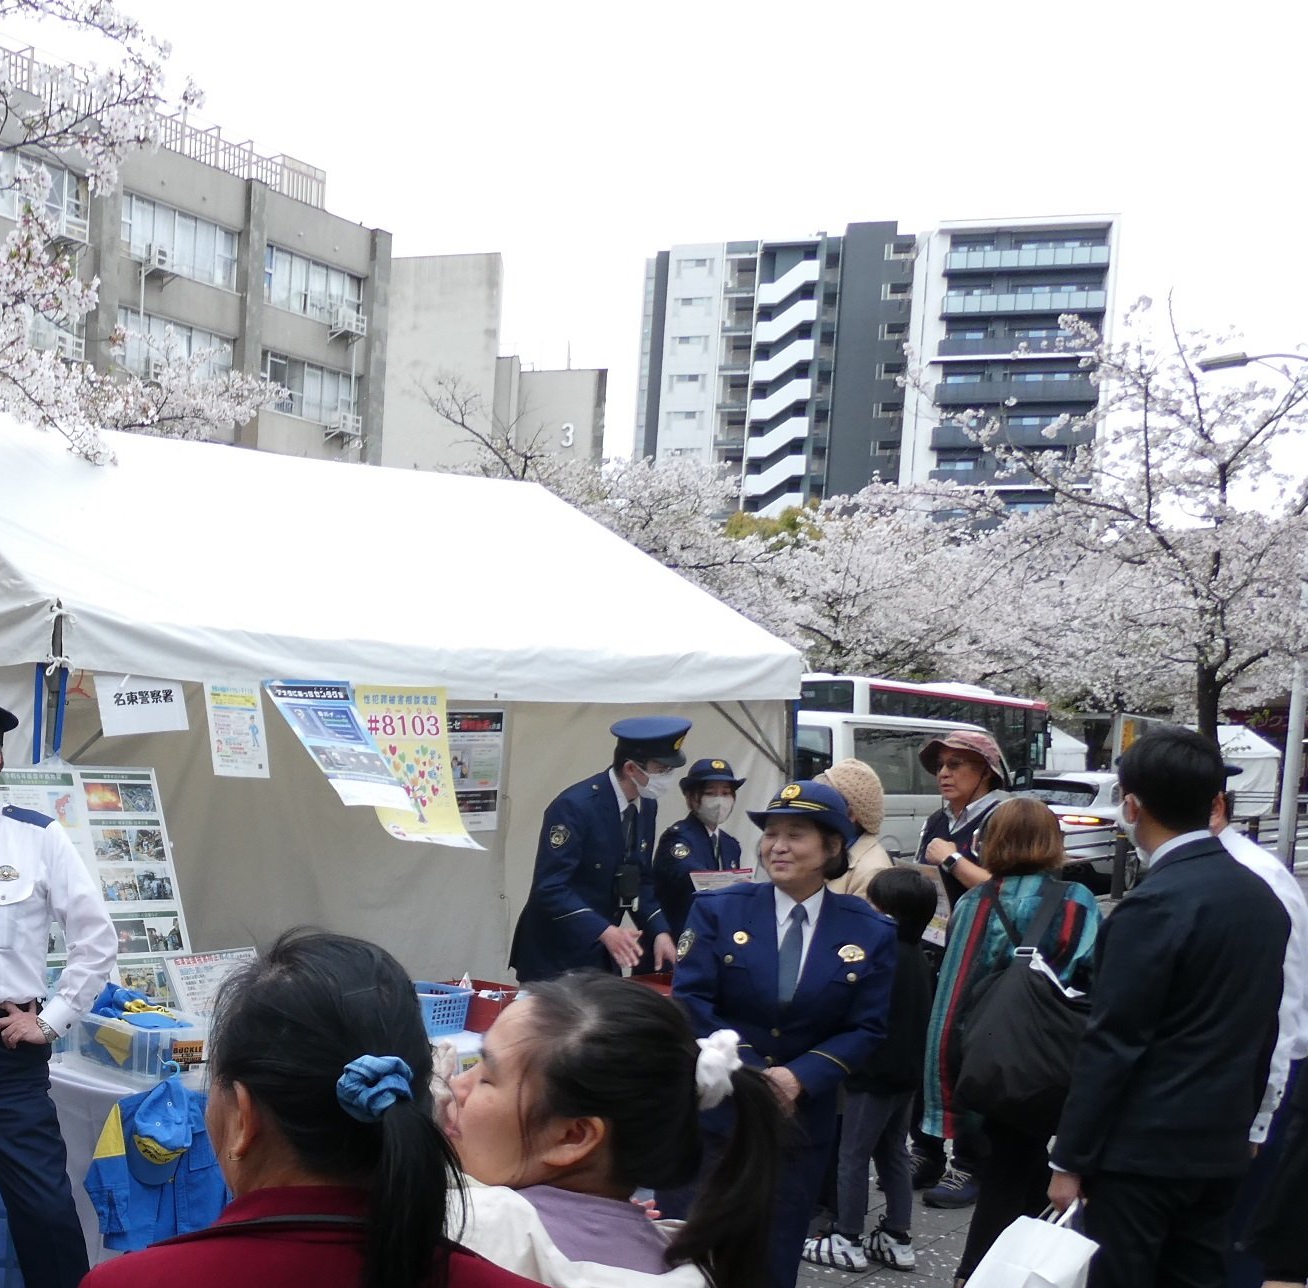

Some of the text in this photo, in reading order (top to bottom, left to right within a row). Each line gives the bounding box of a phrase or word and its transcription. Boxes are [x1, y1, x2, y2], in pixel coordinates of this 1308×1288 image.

[113, 689, 174, 706] 名東警察署
[367, 714, 440, 736] #8103
[173, 1046, 203, 1055] BUCKLE
